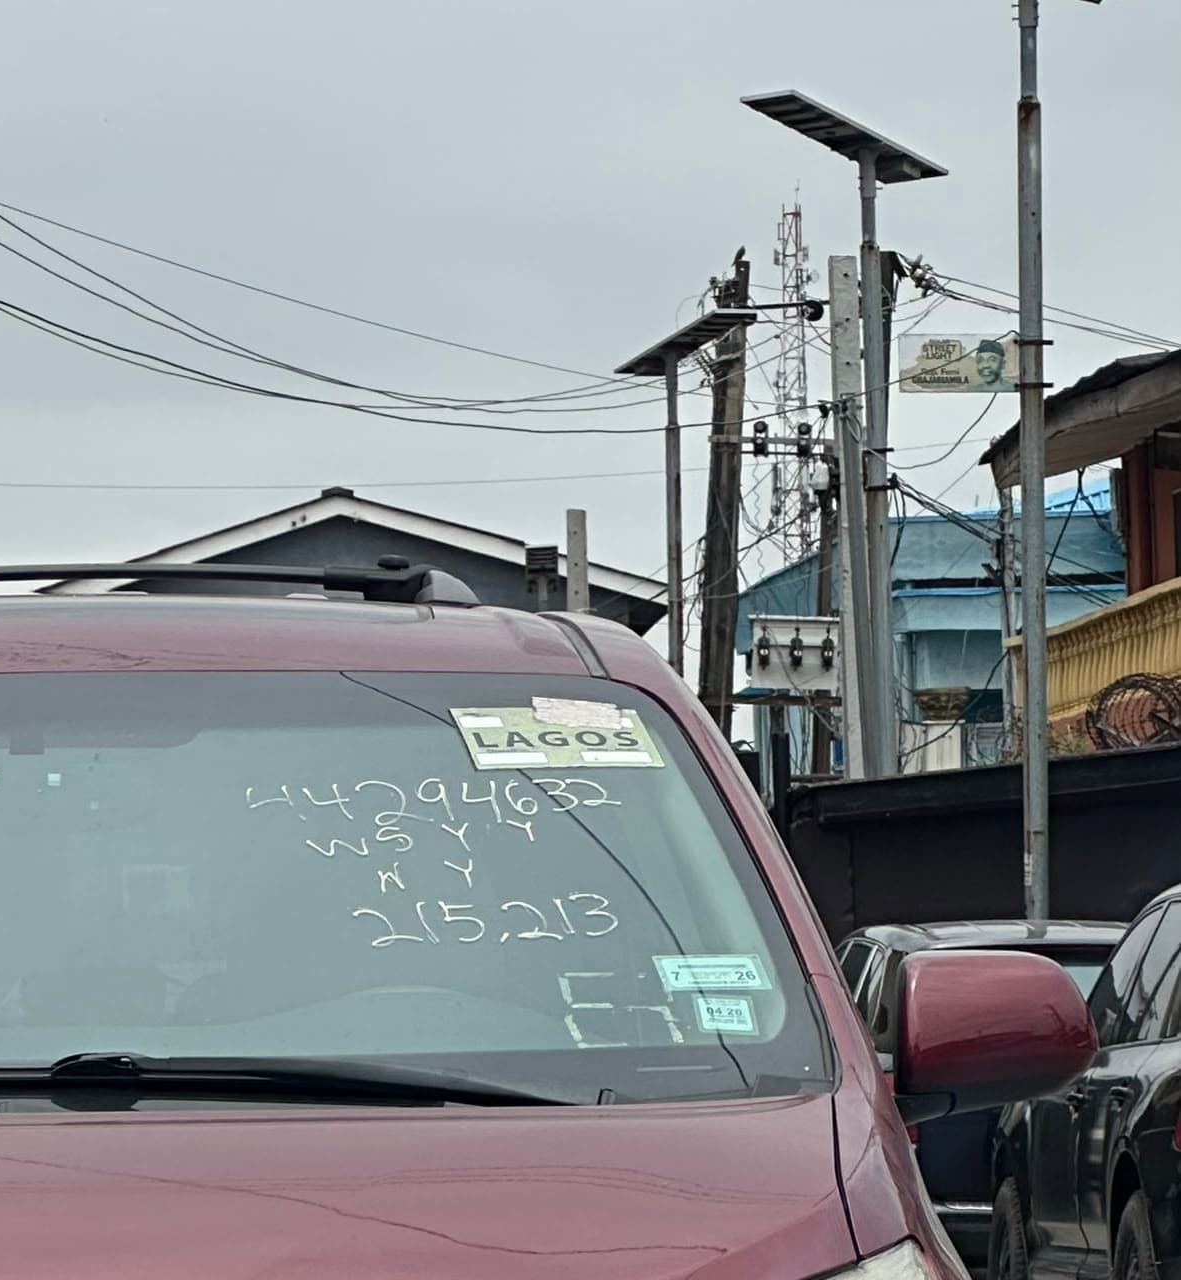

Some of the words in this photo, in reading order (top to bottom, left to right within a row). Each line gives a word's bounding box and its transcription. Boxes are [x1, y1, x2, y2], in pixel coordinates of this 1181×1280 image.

[925, 350, 952, 360] LIGHT
[472, 730, 639, 748] LAGOS
[735, 970, 756, 981] 26
